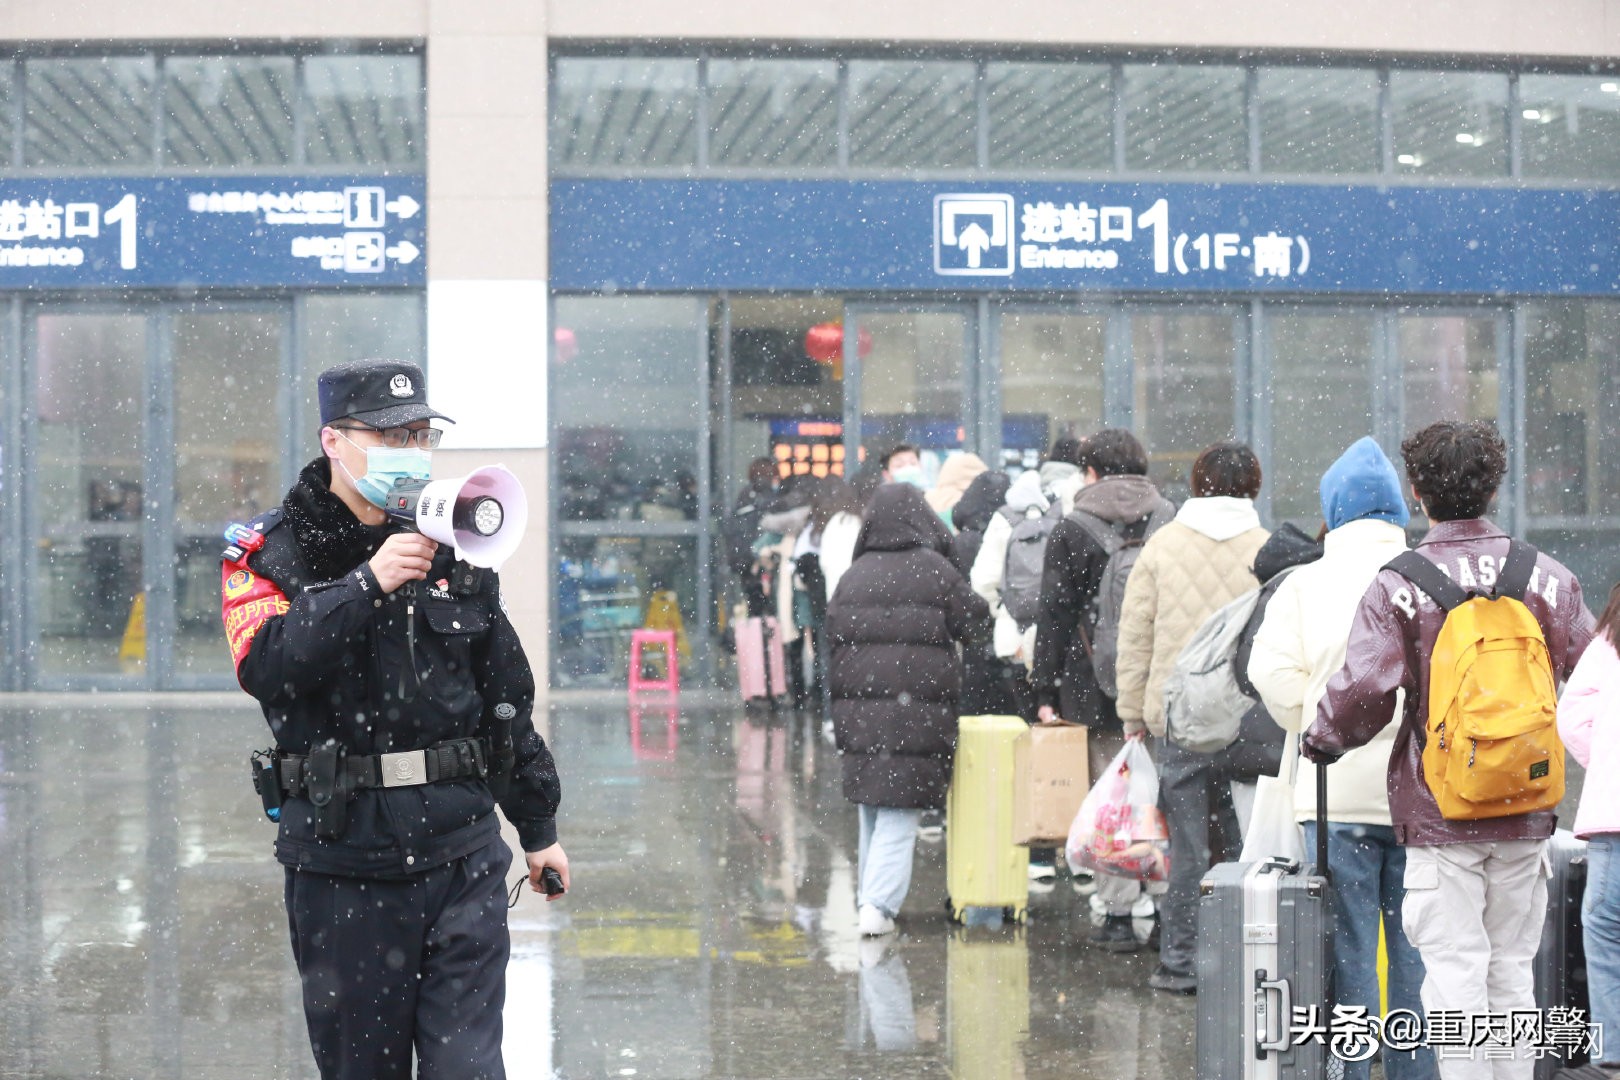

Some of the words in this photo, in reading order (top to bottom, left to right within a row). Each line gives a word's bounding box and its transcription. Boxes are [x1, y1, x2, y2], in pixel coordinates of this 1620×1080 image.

[0, 199, 99, 240] 进站口
[104, 194, 137, 270] 1
[0, 245, 84, 267] ntrance
[1020, 245, 1118, 269] Entrance
[1021, 202, 1133, 243] 进站口
[1137, 199, 1169, 274] 1
[1391, 555, 1560, 620] PASNA
